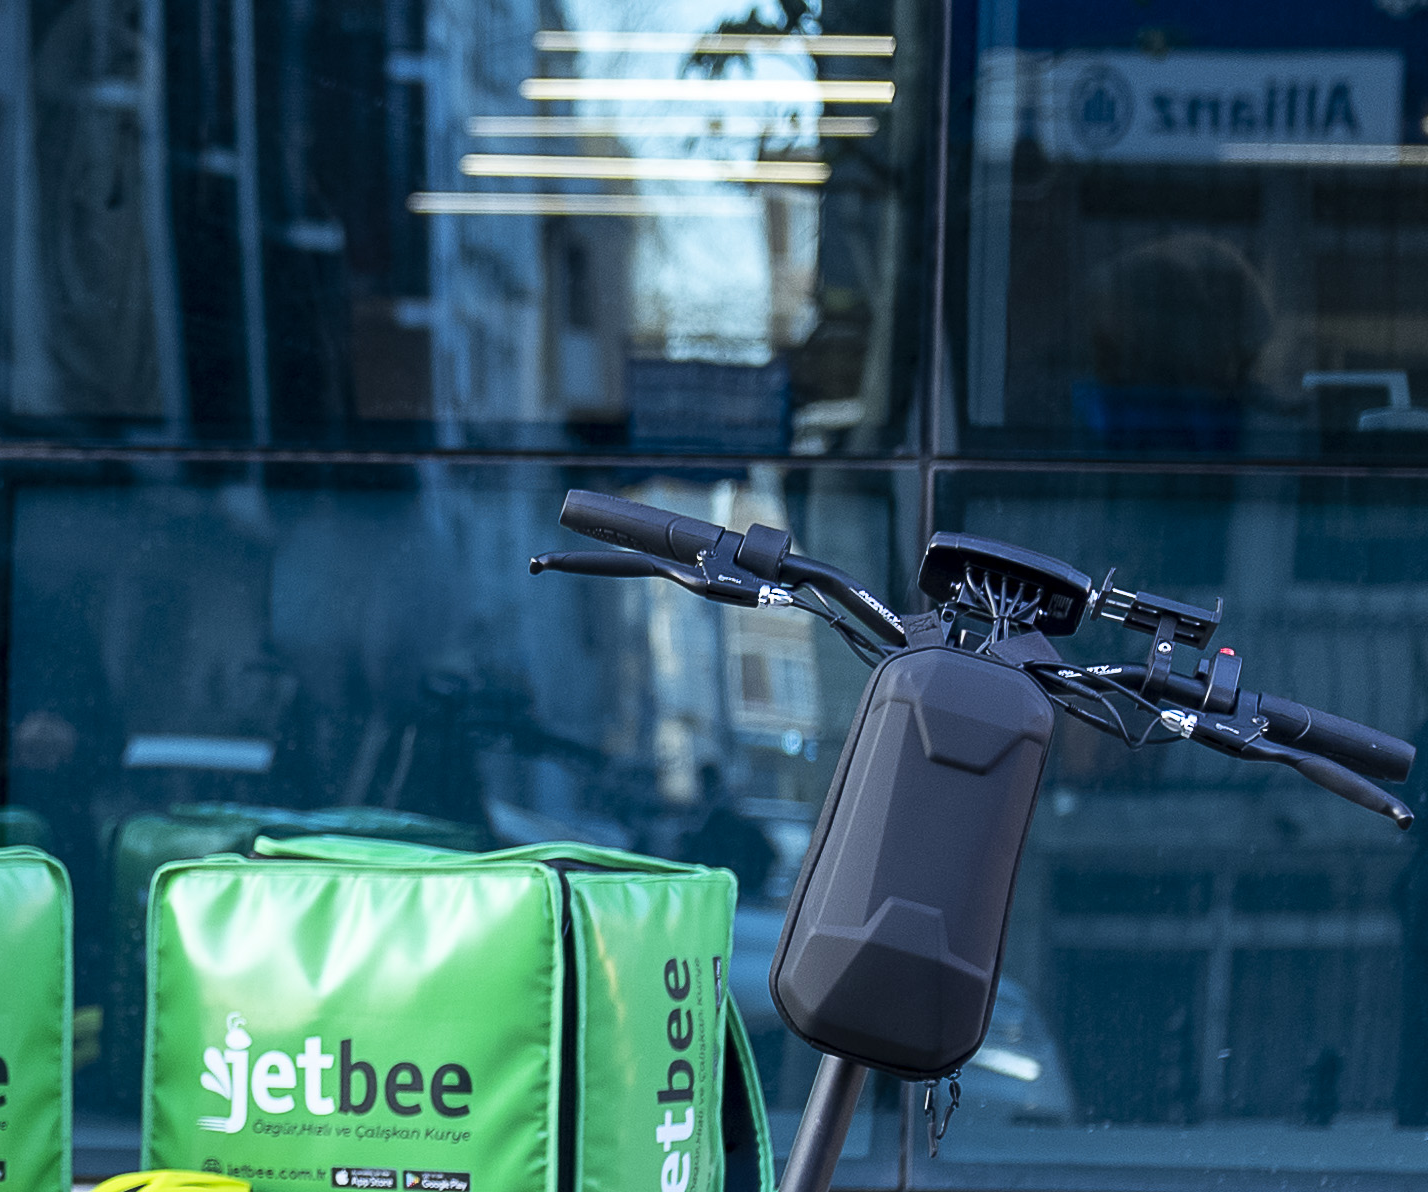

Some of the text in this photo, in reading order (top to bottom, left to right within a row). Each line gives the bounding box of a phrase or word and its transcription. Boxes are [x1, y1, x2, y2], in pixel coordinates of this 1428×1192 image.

[220, 1029, 473, 1134] jetbee
[335, 1126, 351, 1138] ve
[354, 1125, 420, 1142] Çalışkan
[424, 1127, 471, 1144] Kurye
